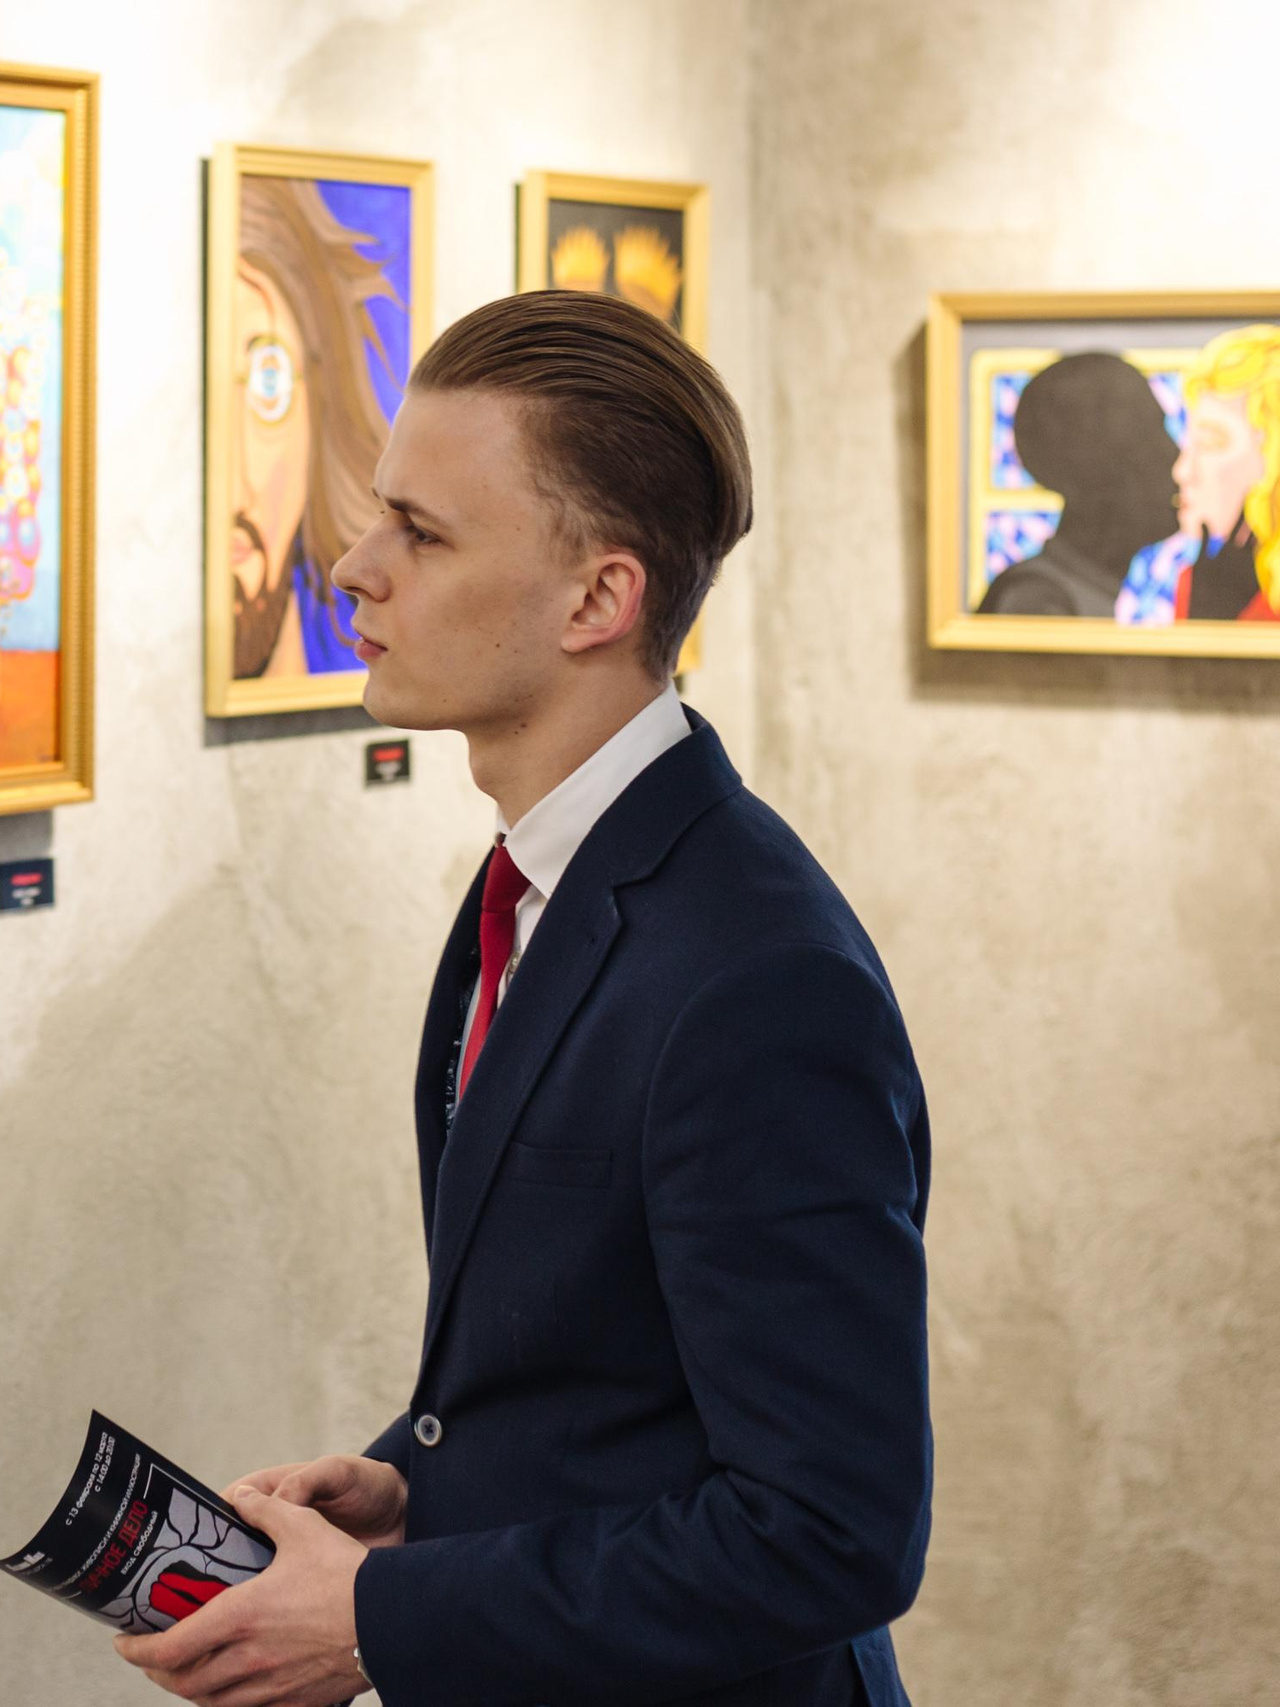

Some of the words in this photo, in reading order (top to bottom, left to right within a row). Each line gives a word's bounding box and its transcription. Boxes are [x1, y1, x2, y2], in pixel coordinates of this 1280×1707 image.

[95, 1453, 103, 1463] 12
[93, 1463, 100, 1475] по
[97, 1465, 109, 1485] 14:00
[105, 1455, 112, 1467] до
[69, 1507, 79, 1518] 13
[119, 1501, 149, 1548] ДЕЛО
[121, 1557, 137, 1576] вход
[134, 1510, 158, 1557] свободный
